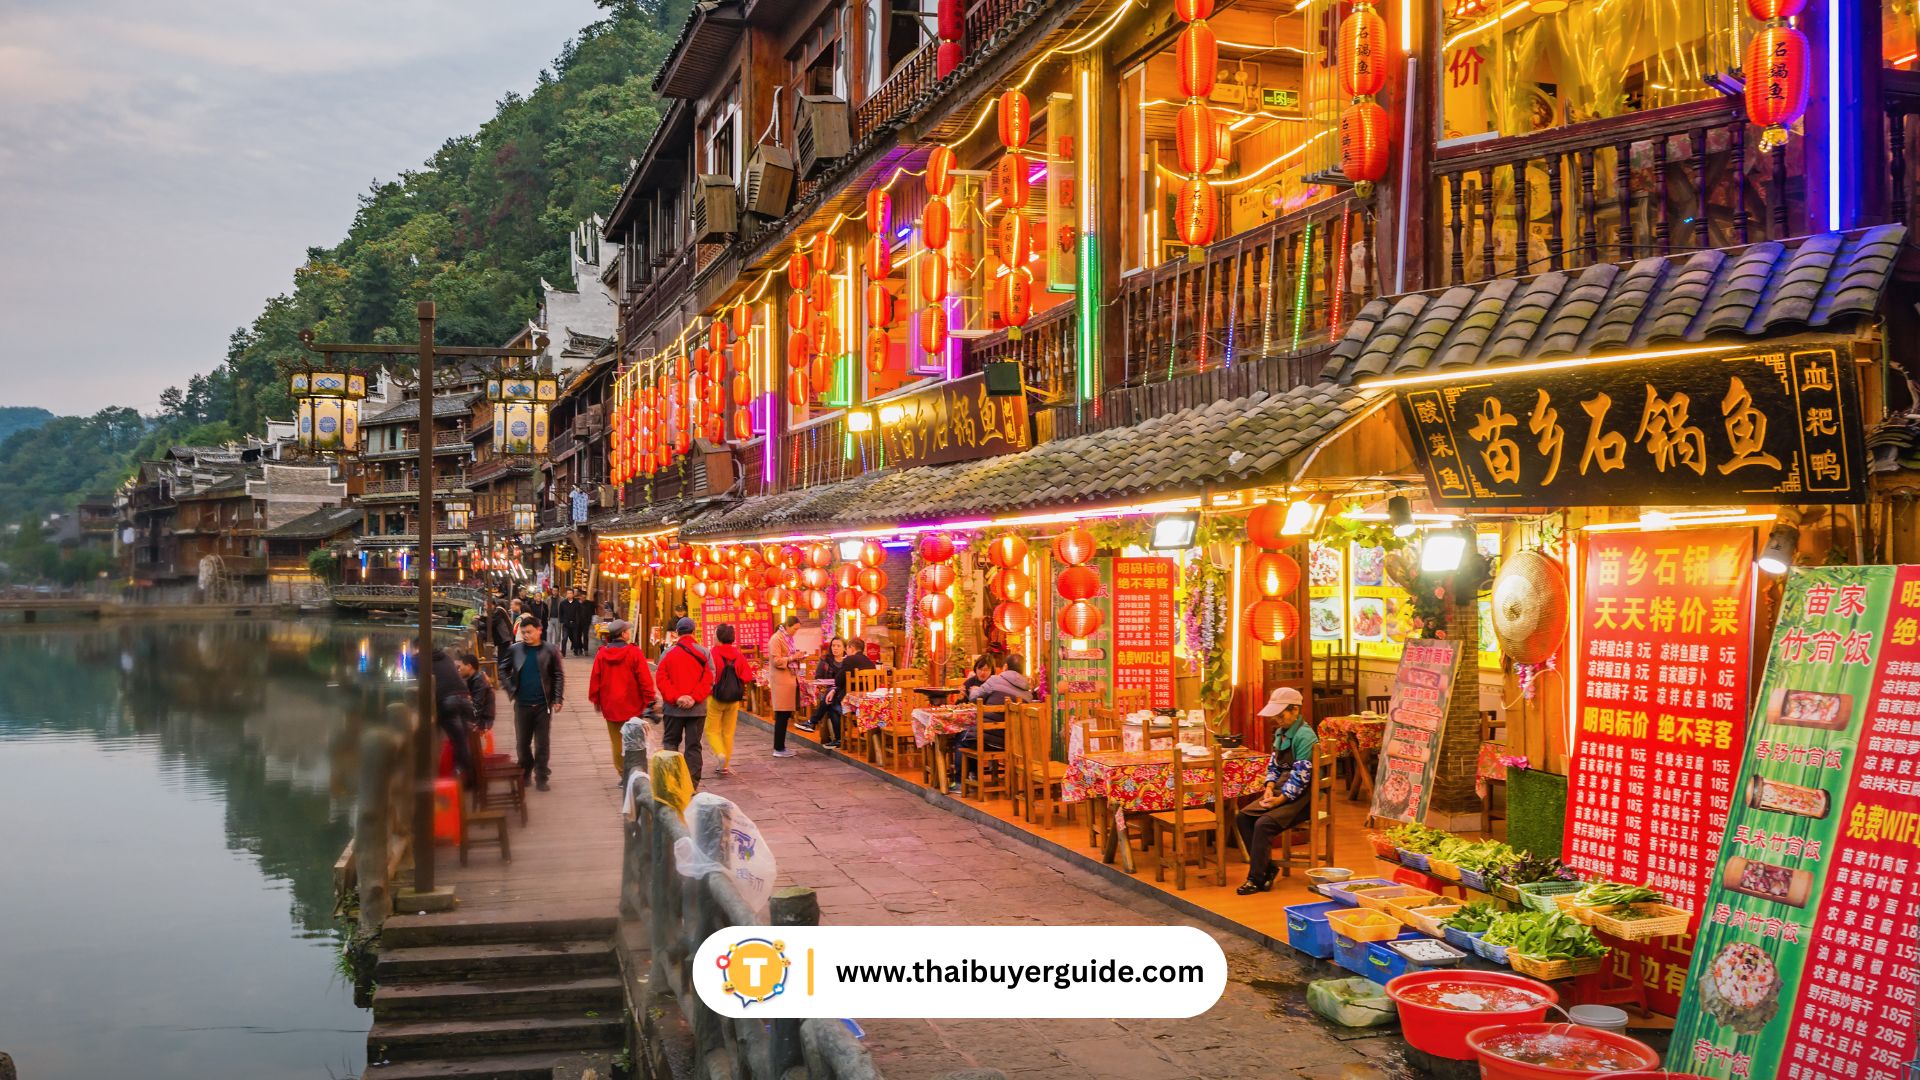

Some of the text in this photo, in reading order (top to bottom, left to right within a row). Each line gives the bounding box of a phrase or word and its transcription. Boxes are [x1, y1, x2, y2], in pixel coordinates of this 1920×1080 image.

[1449, 47, 1485, 88] 价
[1468, 376, 1782, 487] 苗乡石锅鱼
[1801, 361, 1841, 481] 血粑鸭
[1414, 400, 1465, 491] 酸菜鱼
[1117, 563, 1169, 574] 明码标价
[1598, 544, 1741, 586] 苗乡石锅鱼
[1117, 577, 1169, 589] 绝不宰客
[1806, 583, 1867, 617] 苗家
[1593, 596, 1740, 636] 天天特价菜
[1890, 617, 1920, 645] 绝
[1589, 639, 1652, 659] 凉拌酸白菜 3元
[1719, 646, 1736, 664] 5元
[1779, 627, 1873, 667] 竹筒饭
[1587, 660, 1650, 681] 凉拌酸豆角 3元
[1658, 665, 1736, 687] 苗家酸萝卜 8元
[1633, 685, 1648, 702] 3元
[1711, 692, 1735, 710] 18元
[1583, 706, 1734, 749] 明码标价 绝不宰客
[1581, 741, 1647, 762] 苗家竹筒饭 15元
[1755, 739, 1843, 770] 香肠竹筒饭
[1629, 765, 1646, 779] 15元
[1654, 768, 1729, 792] 农家豆腐 18元
[1712, 759, 1731, 774] 15元
[1628, 782, 1645, 796] 18元
[1710, 795, 1729, 810] 18元
[1627, 799, 1643, 813] 18元
[1625, 816, 1642, 830] 18元
[1846, 801, 1920, 849] 免费WIFI
[1624, 833, 1641, 847] 18元
[1732, 825, 1822, 861] 玉米竹筒饭
[1623, 850, 1640, 864] 18元
[1841, 847, 1909, 876] 苗家竹筒饭
[1620, 866, 1638, 881] 38元
[1836, 867, 1904, 896] 苗家荷叶饭
[1711, 902, 1800, 944] 腊肉竹筒饭
[1827, 906, 1894, 935] 农家豆腐
[1821, 925, 1889, 955] 红烧米豆腐
[1812, 964, 1917, 1007] 农家烧茄子 18元
[1890, 963, 1920, 985] 18元
[1803, 1003, 1907, 1048] 香干炒肉丝 28元
[1880, 1005, 1912, 1028] 18元
[1694, 1037, 1751, 1078] 荷叶饭
[1798, 1022, 1902, 1069] 铁板土豆片 28元
[1793, 1042, 1858, 1078] 苗家土匪鸡
